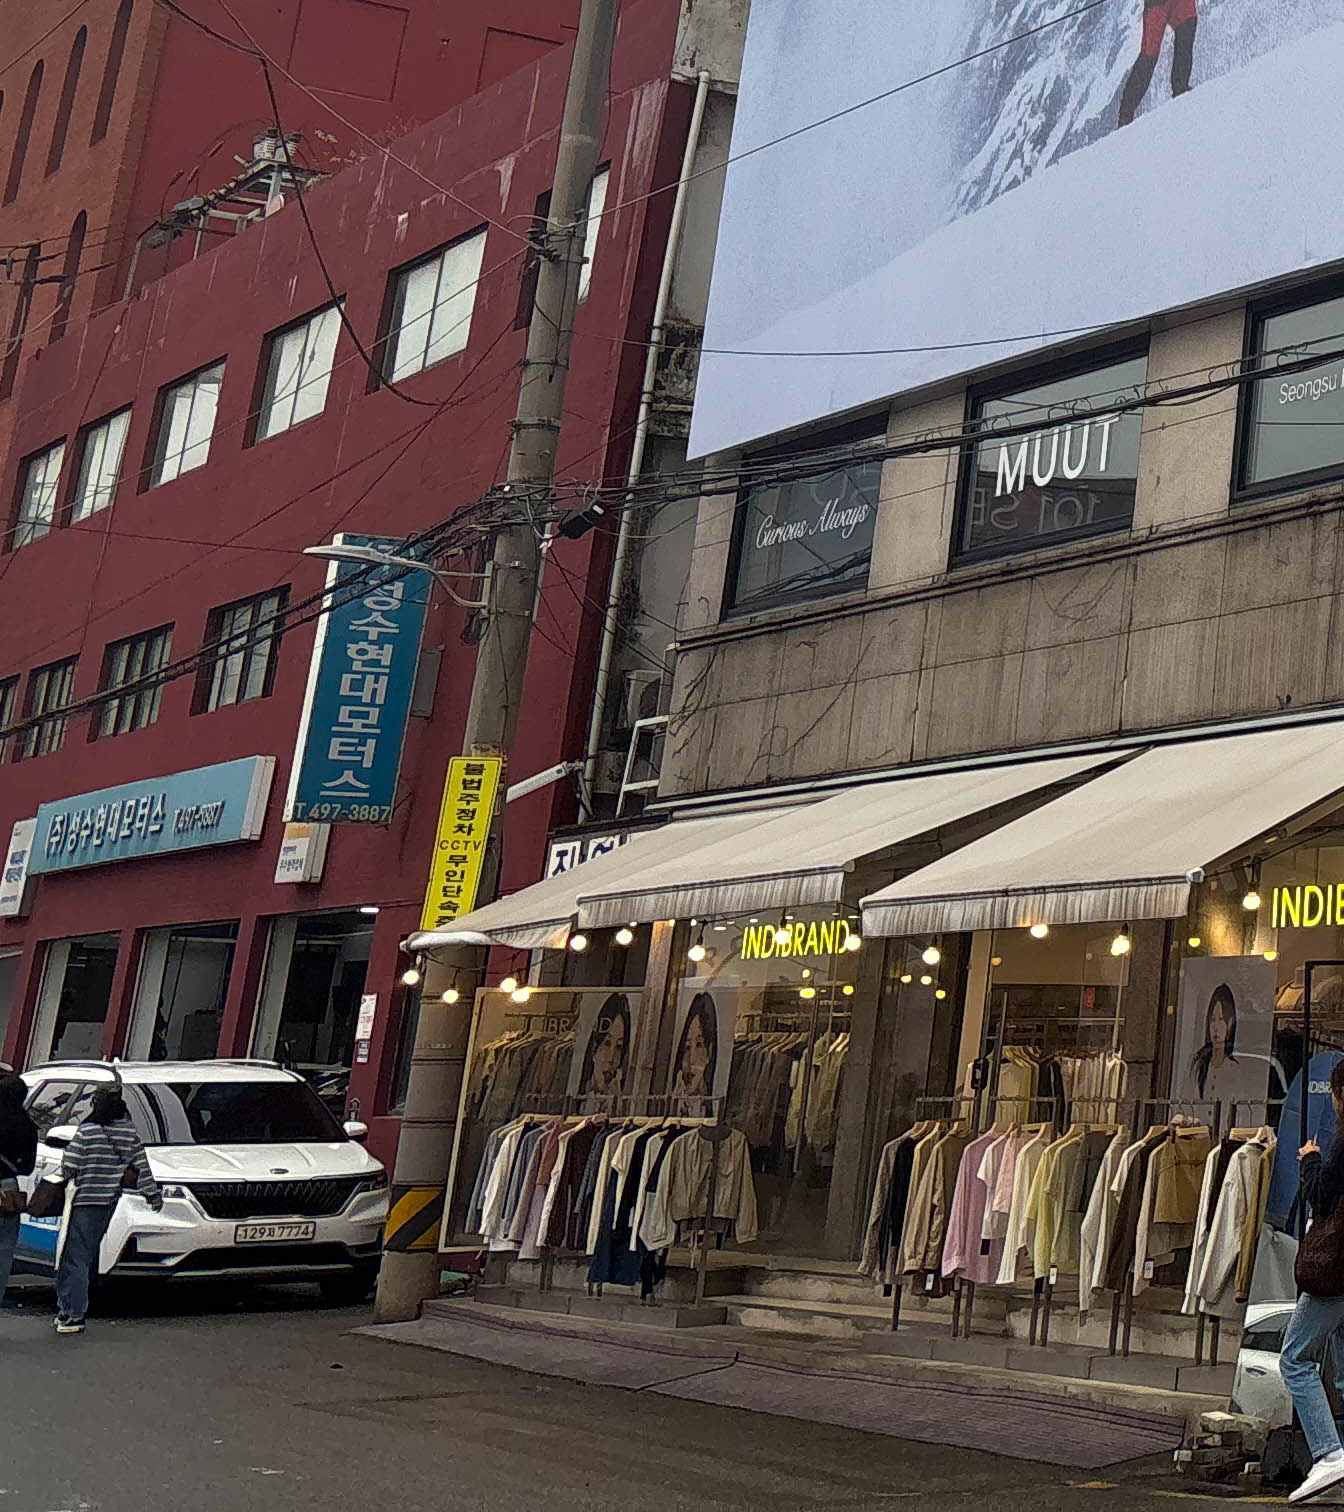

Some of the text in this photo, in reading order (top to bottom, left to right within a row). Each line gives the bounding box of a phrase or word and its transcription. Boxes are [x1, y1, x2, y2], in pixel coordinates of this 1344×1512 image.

[1279, 374, 1338, 404] Seongsu
[995, 412, 1120, 497] MUUT
[756, 497, 870, 549] Curious Always
[452, 762, 486, 837] 불법주정차
[439, 839, 482, 852] CCTV
[740, 919, 851, 960] INDIBRAND
